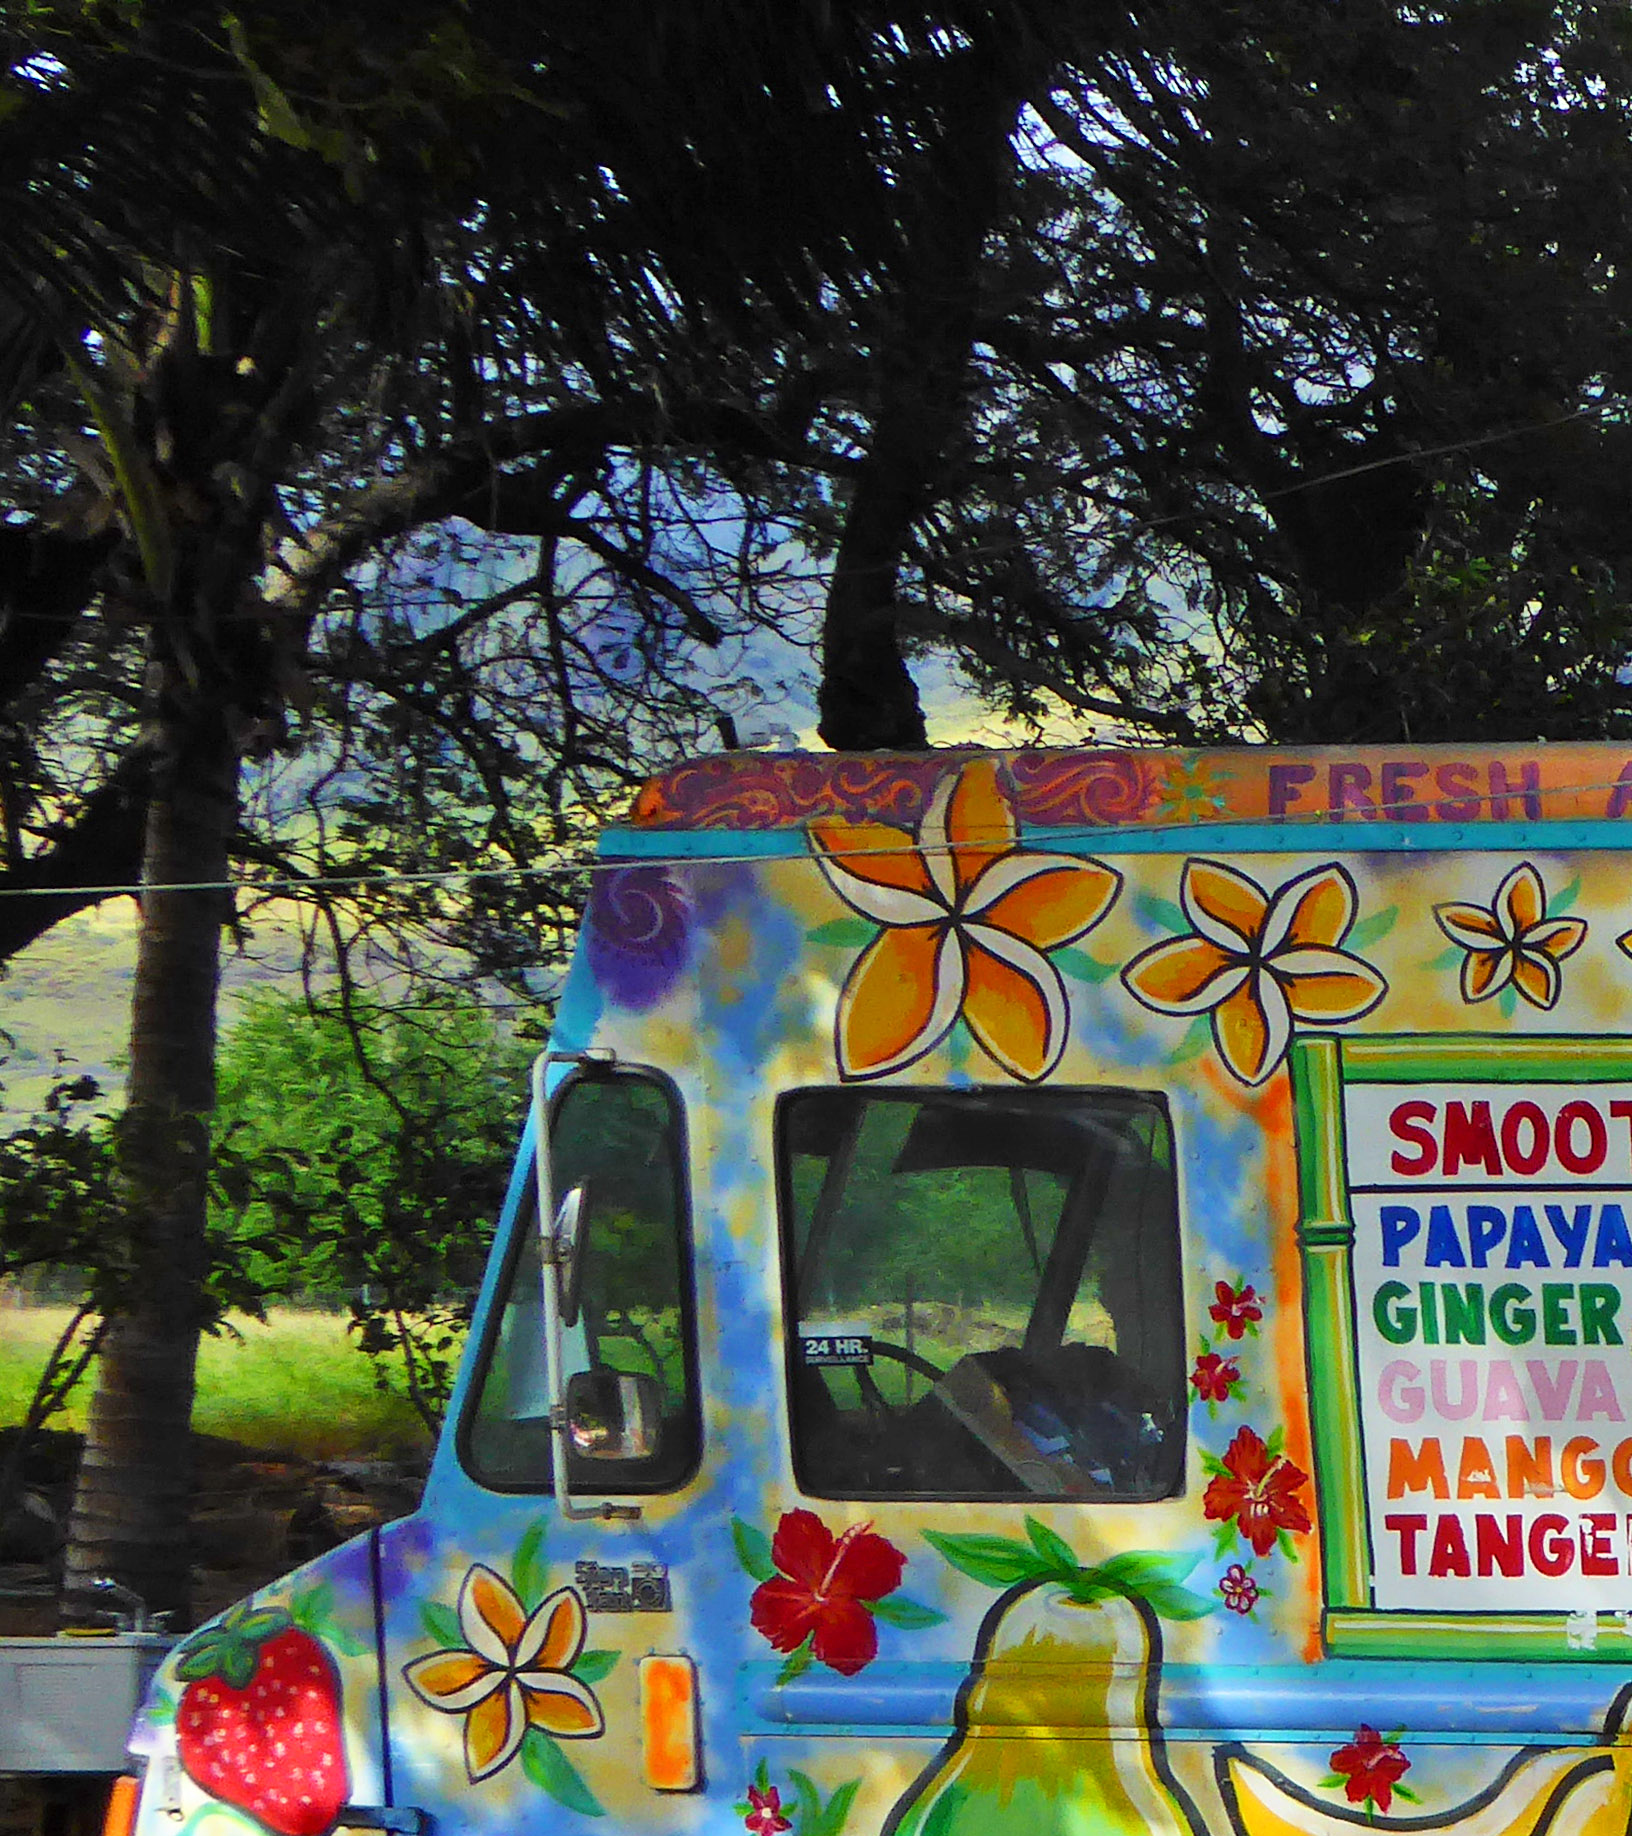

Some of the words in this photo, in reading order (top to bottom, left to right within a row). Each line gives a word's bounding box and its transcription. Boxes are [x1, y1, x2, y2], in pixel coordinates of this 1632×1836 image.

[1268, 760, 1542, 823] FRESH
[1373, 1281, 1625, 1347] GINGER
[805, 1340, 829, 1355] 24
[1378, 1359, 1626, 1423] GUAVA
